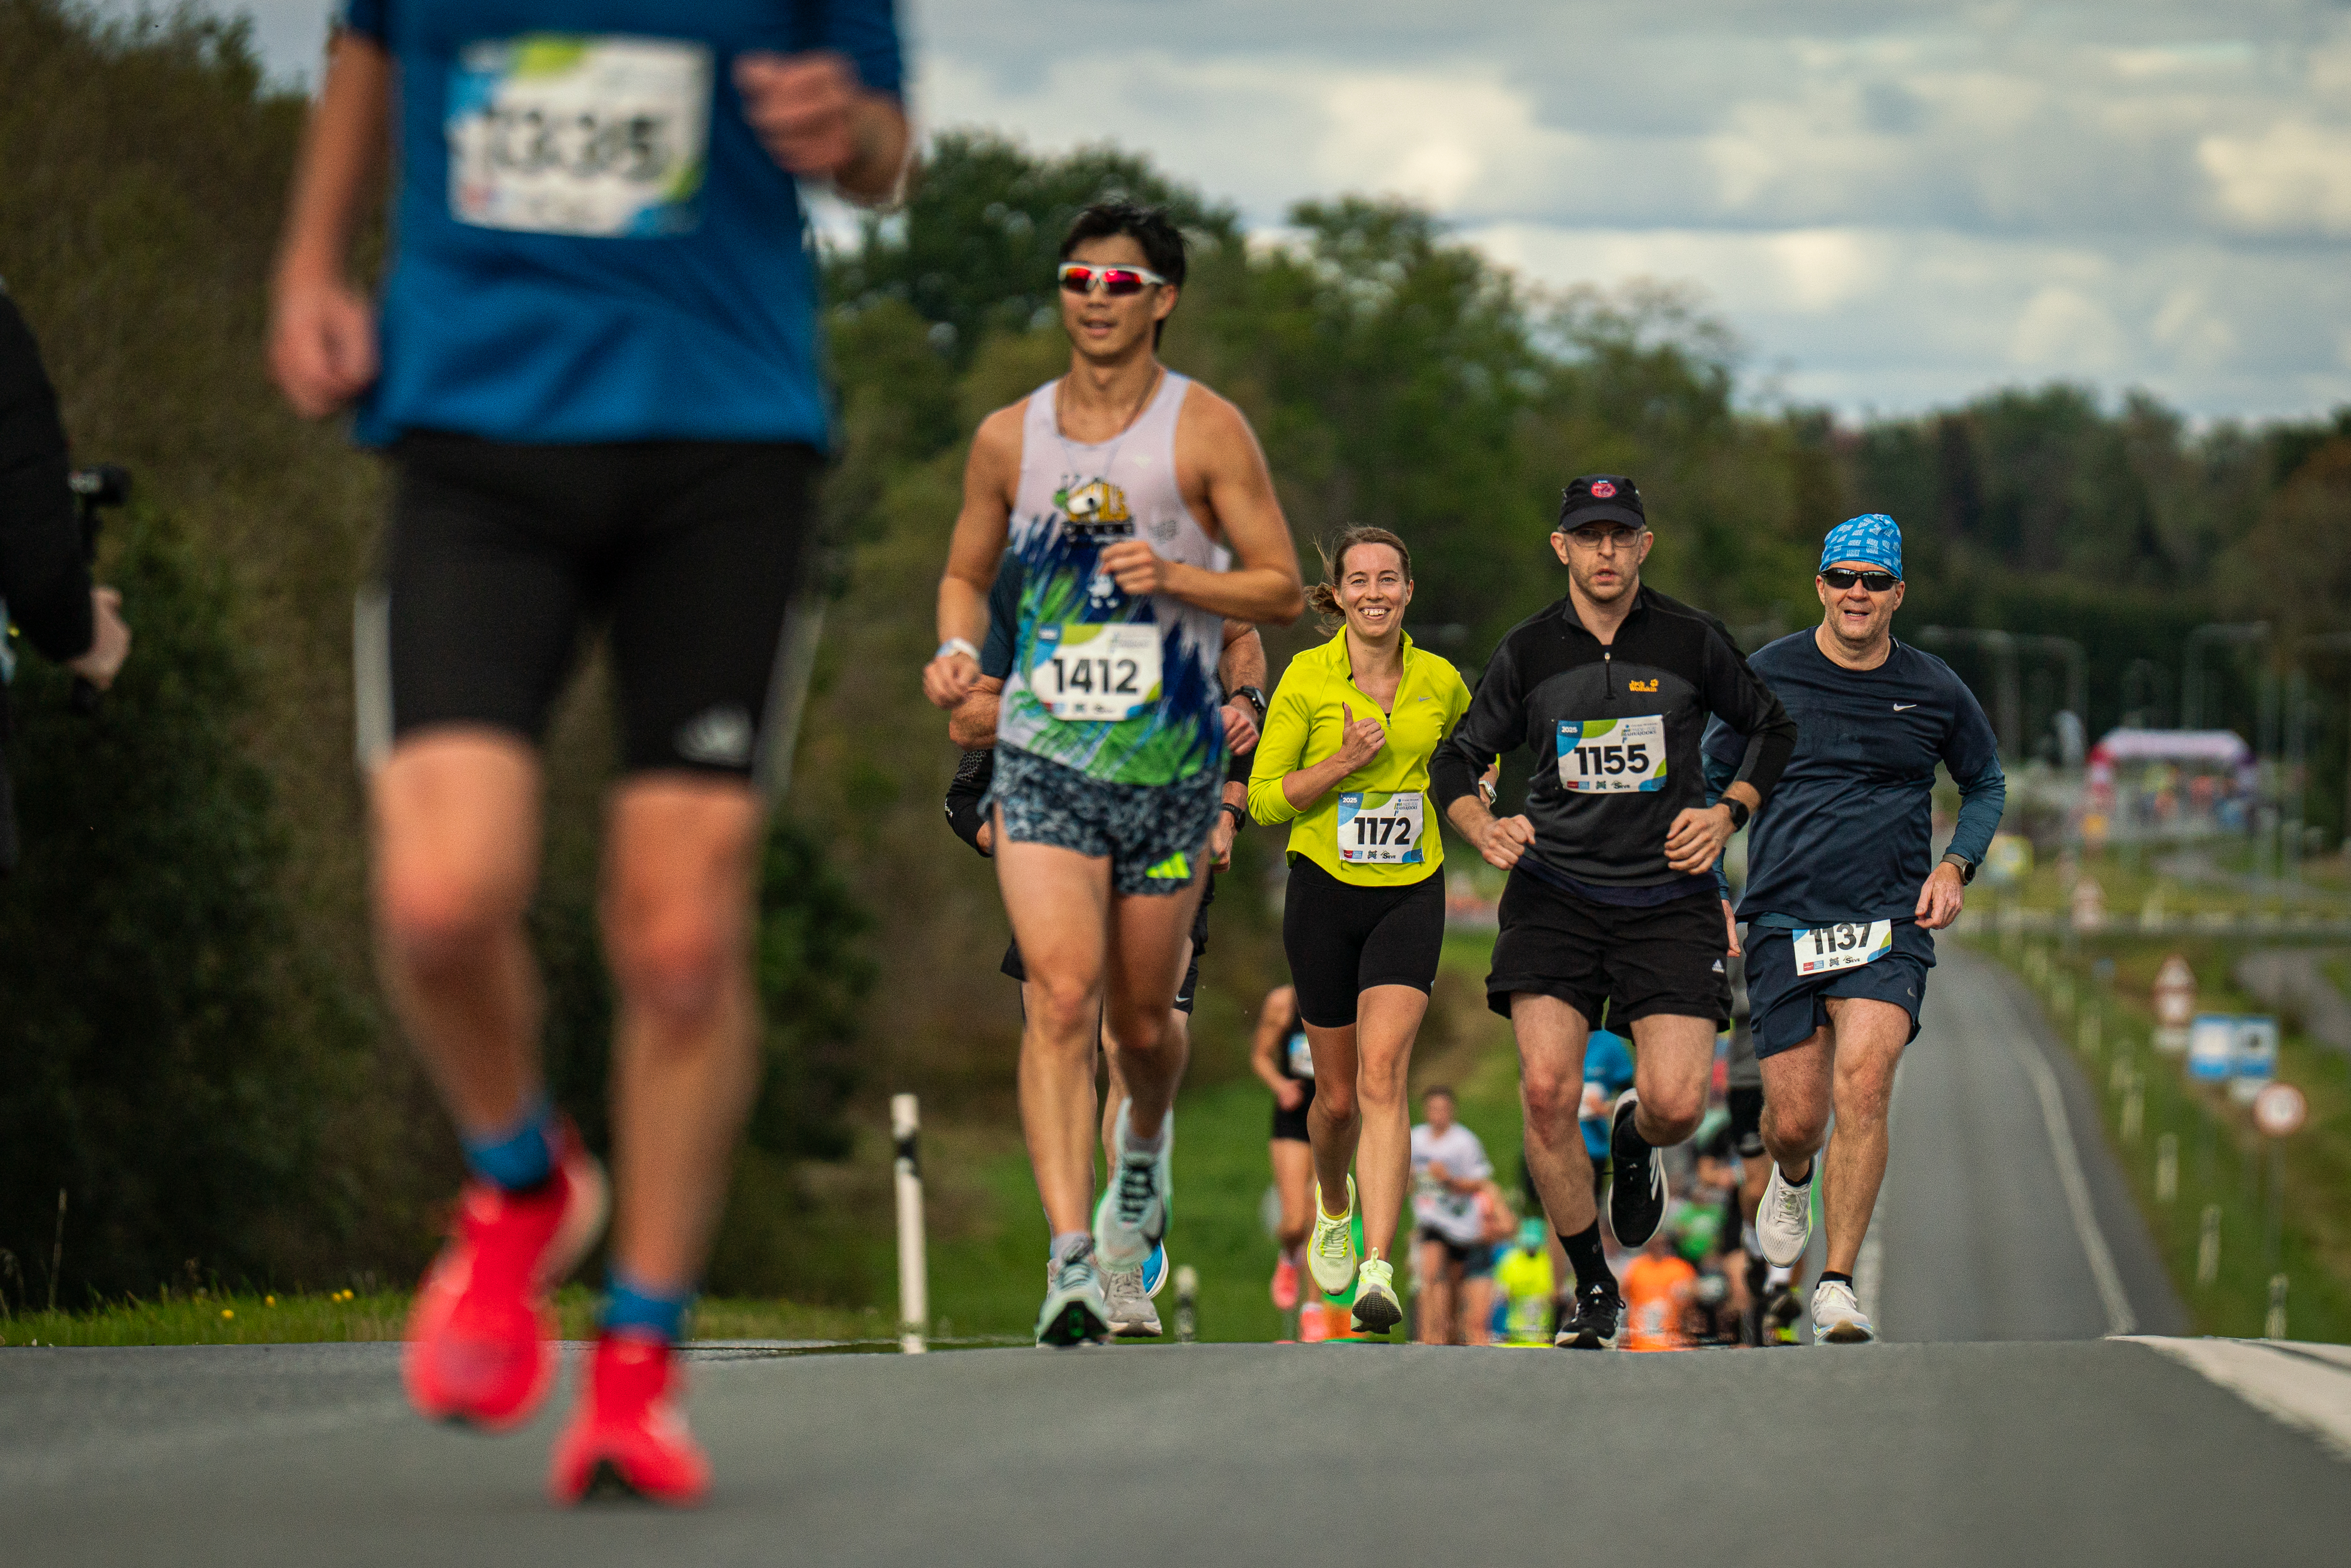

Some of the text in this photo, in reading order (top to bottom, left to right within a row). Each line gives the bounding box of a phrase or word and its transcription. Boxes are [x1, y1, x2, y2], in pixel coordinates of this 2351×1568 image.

[1053, 659, 1137, 693] 1412
[1574, 743, 1649, 775] 1155
[1354, 817, 1411, 845] 1172
[1809, 922, 1873, 955] 1137
